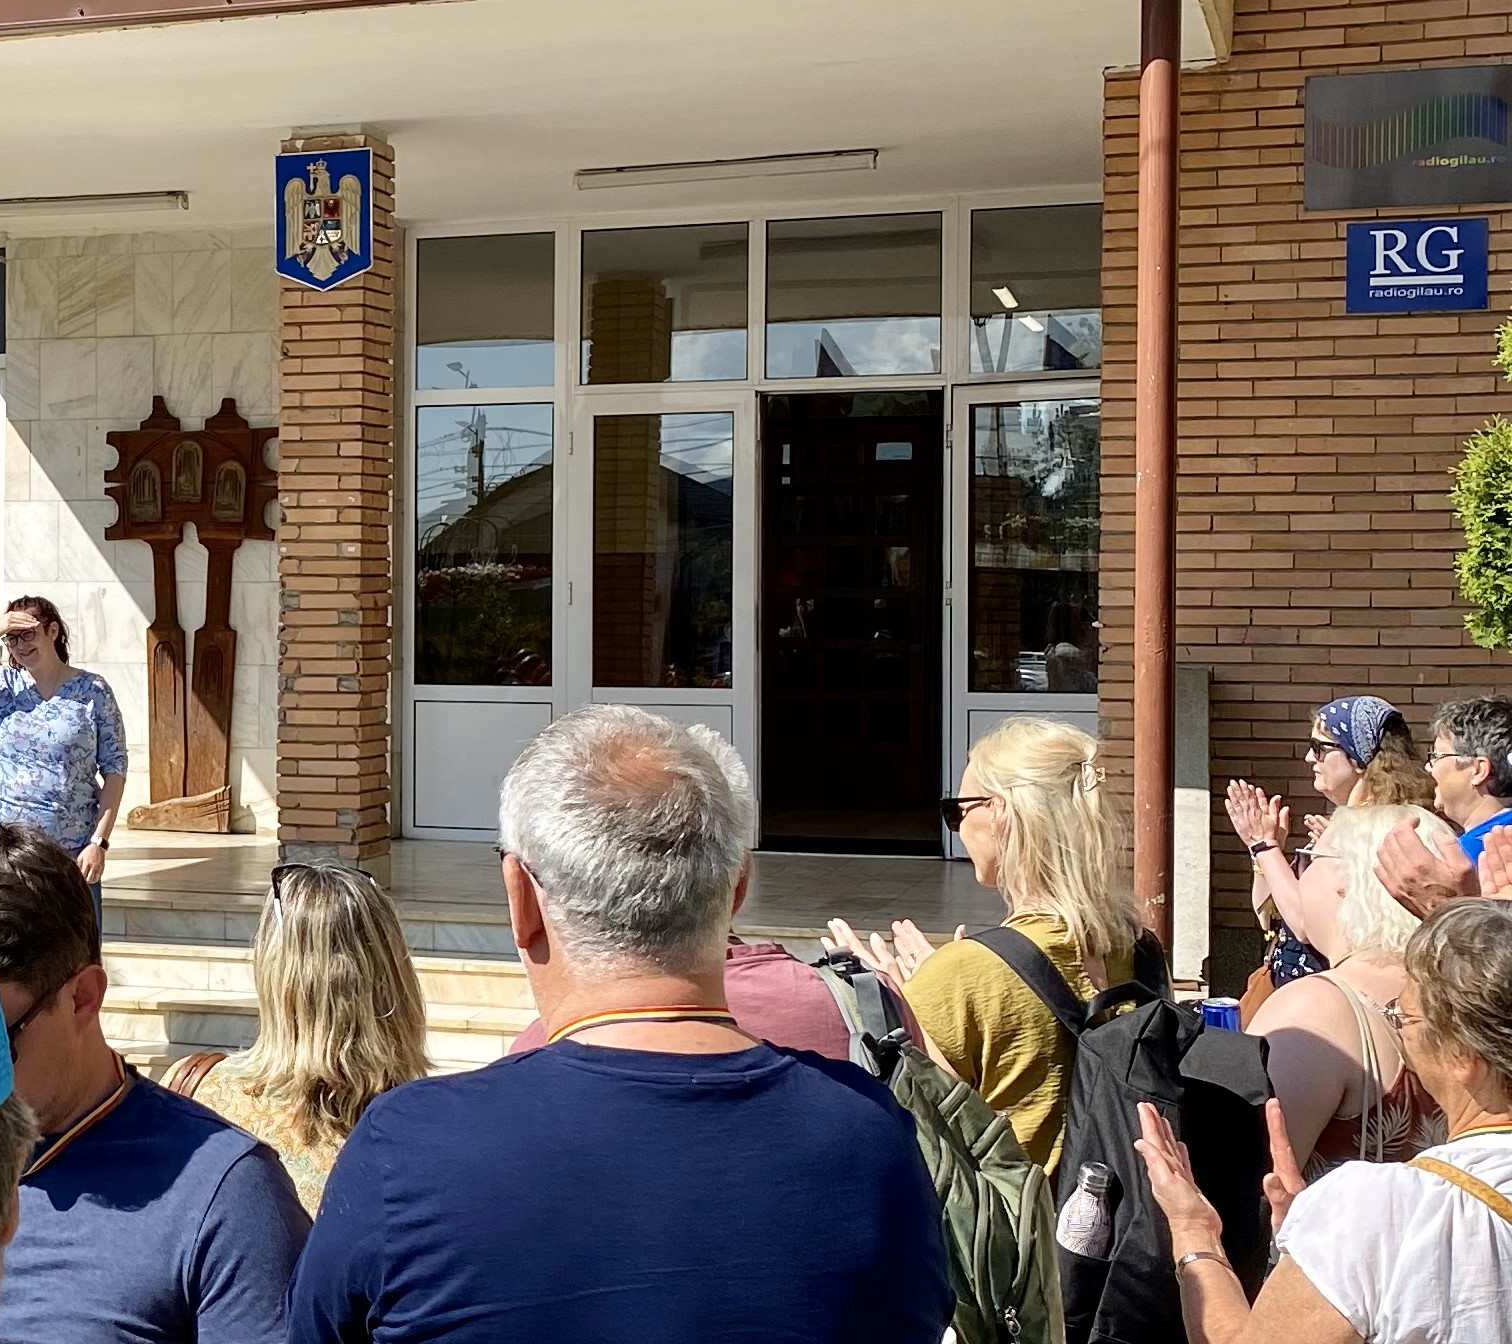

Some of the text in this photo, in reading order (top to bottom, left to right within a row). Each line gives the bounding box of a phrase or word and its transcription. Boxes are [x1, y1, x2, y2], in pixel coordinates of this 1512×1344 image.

[1412, 154, 1506, 168] radiogilau.ro
[1369, 226, 1465, 275] RG
[1369, 286, 1464, 299] radiogilau.ro
